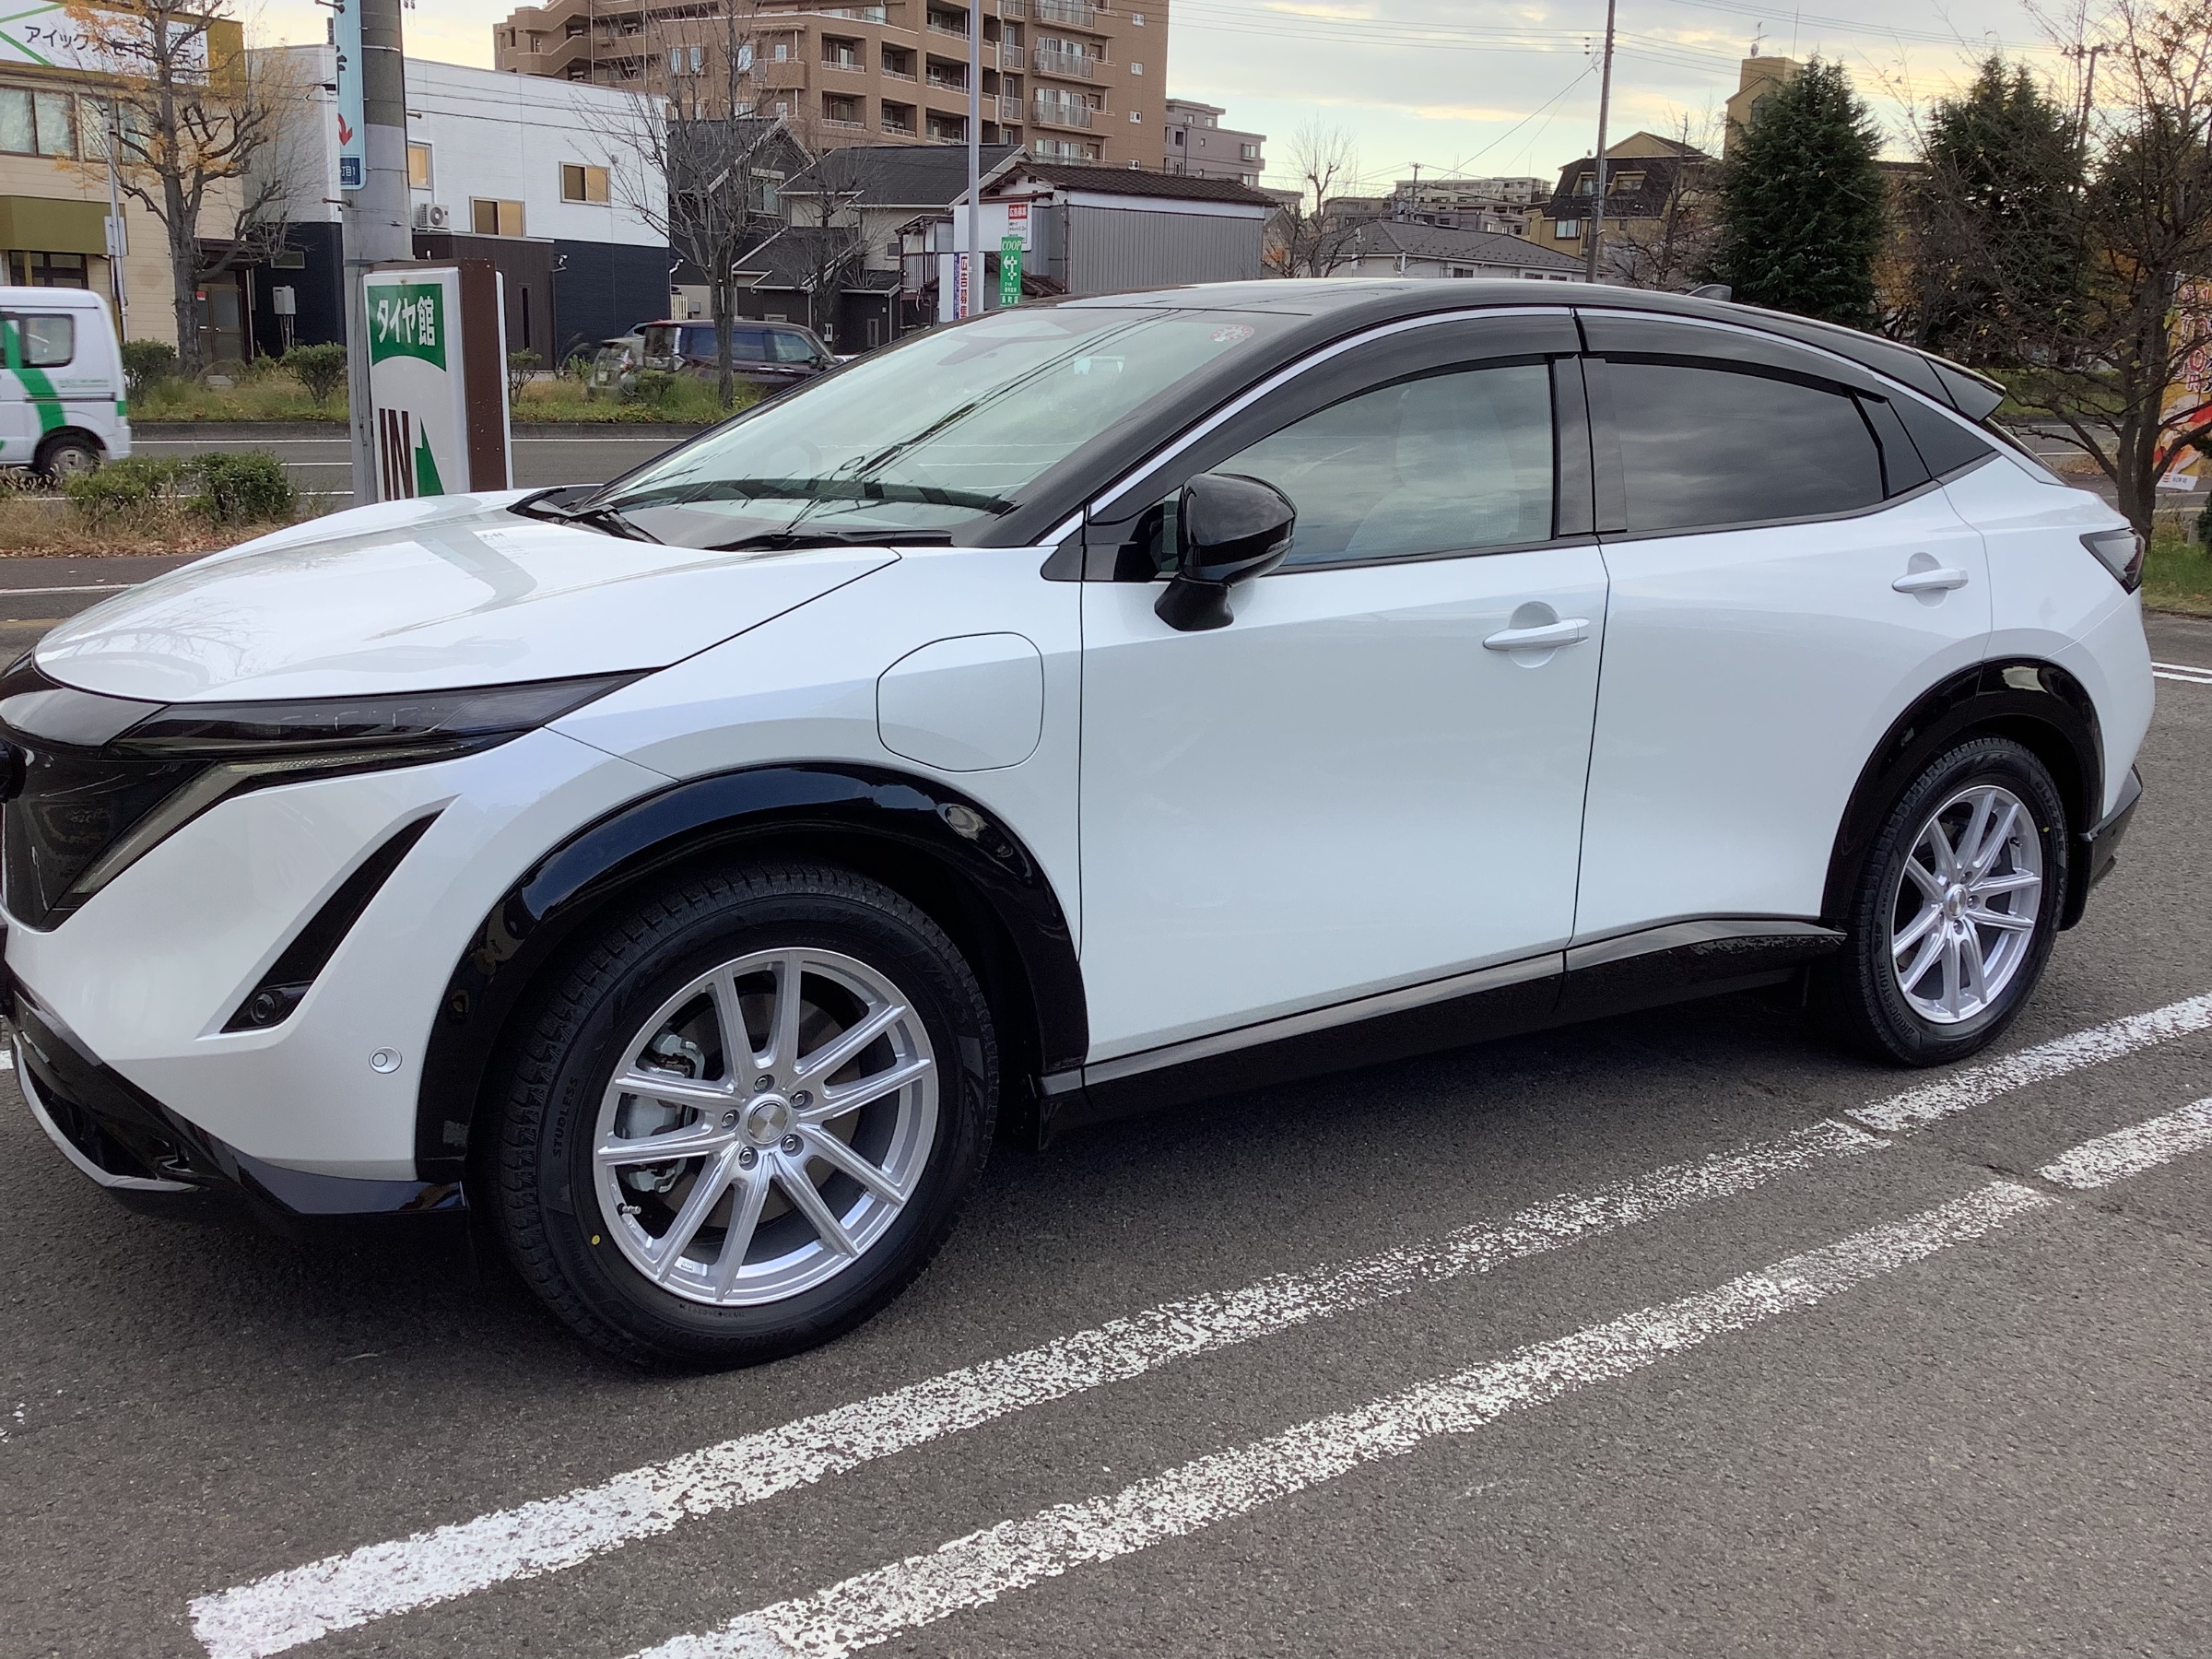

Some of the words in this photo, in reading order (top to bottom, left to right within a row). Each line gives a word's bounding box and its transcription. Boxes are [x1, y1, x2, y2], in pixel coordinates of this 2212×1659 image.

[340, 166, 356, 177] 丁目1
[1001, 240, 1022, 251] COOP
[376, 295, 436, 347] タイヤ館
[378, 407, 414, 500] IN
[1877, 960, 1915, 1040] BRIDGESTONE
[553, 1076, 579, 1159] STUDLESS
